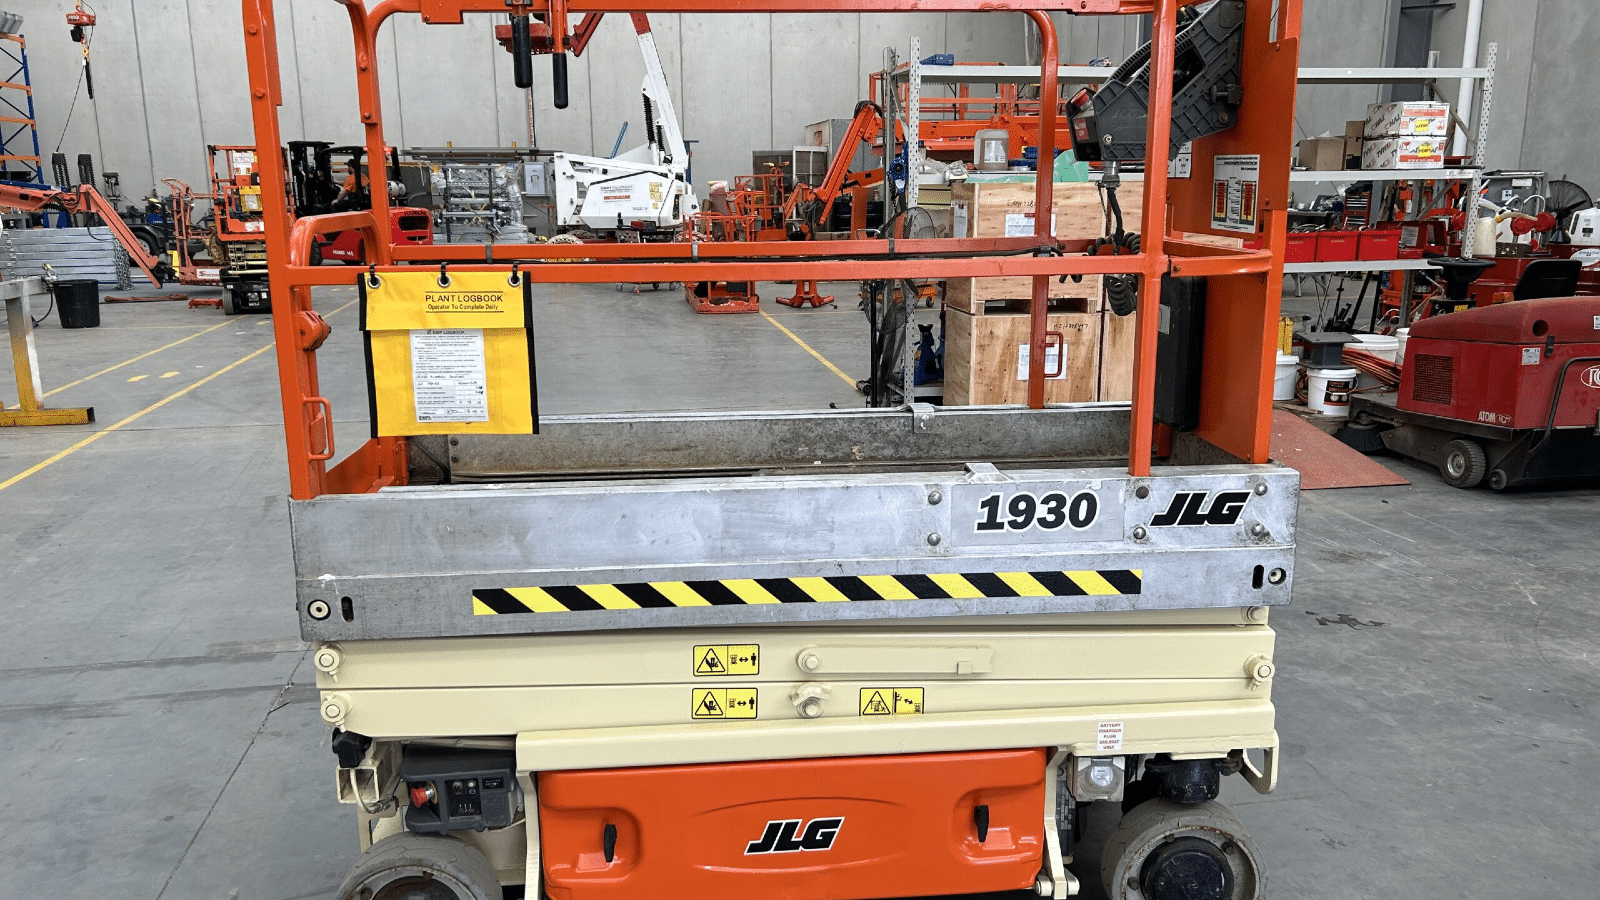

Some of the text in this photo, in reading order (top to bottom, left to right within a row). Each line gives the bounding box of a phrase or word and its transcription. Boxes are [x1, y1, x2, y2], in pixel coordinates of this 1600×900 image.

[425, 294, 503, 302] PLANT LOGBOOK
[427, 303, 450, 311] Operator
[459, 303, 484, 311] Complete
[485, 303, 499, 311] Daily
[1478, 410, 1496, 423] ATOM
[975, 491, 1099, 532] 1930
[1149, 491, 1251, 527] JLG
[744, 817, 845, 855] JLG
